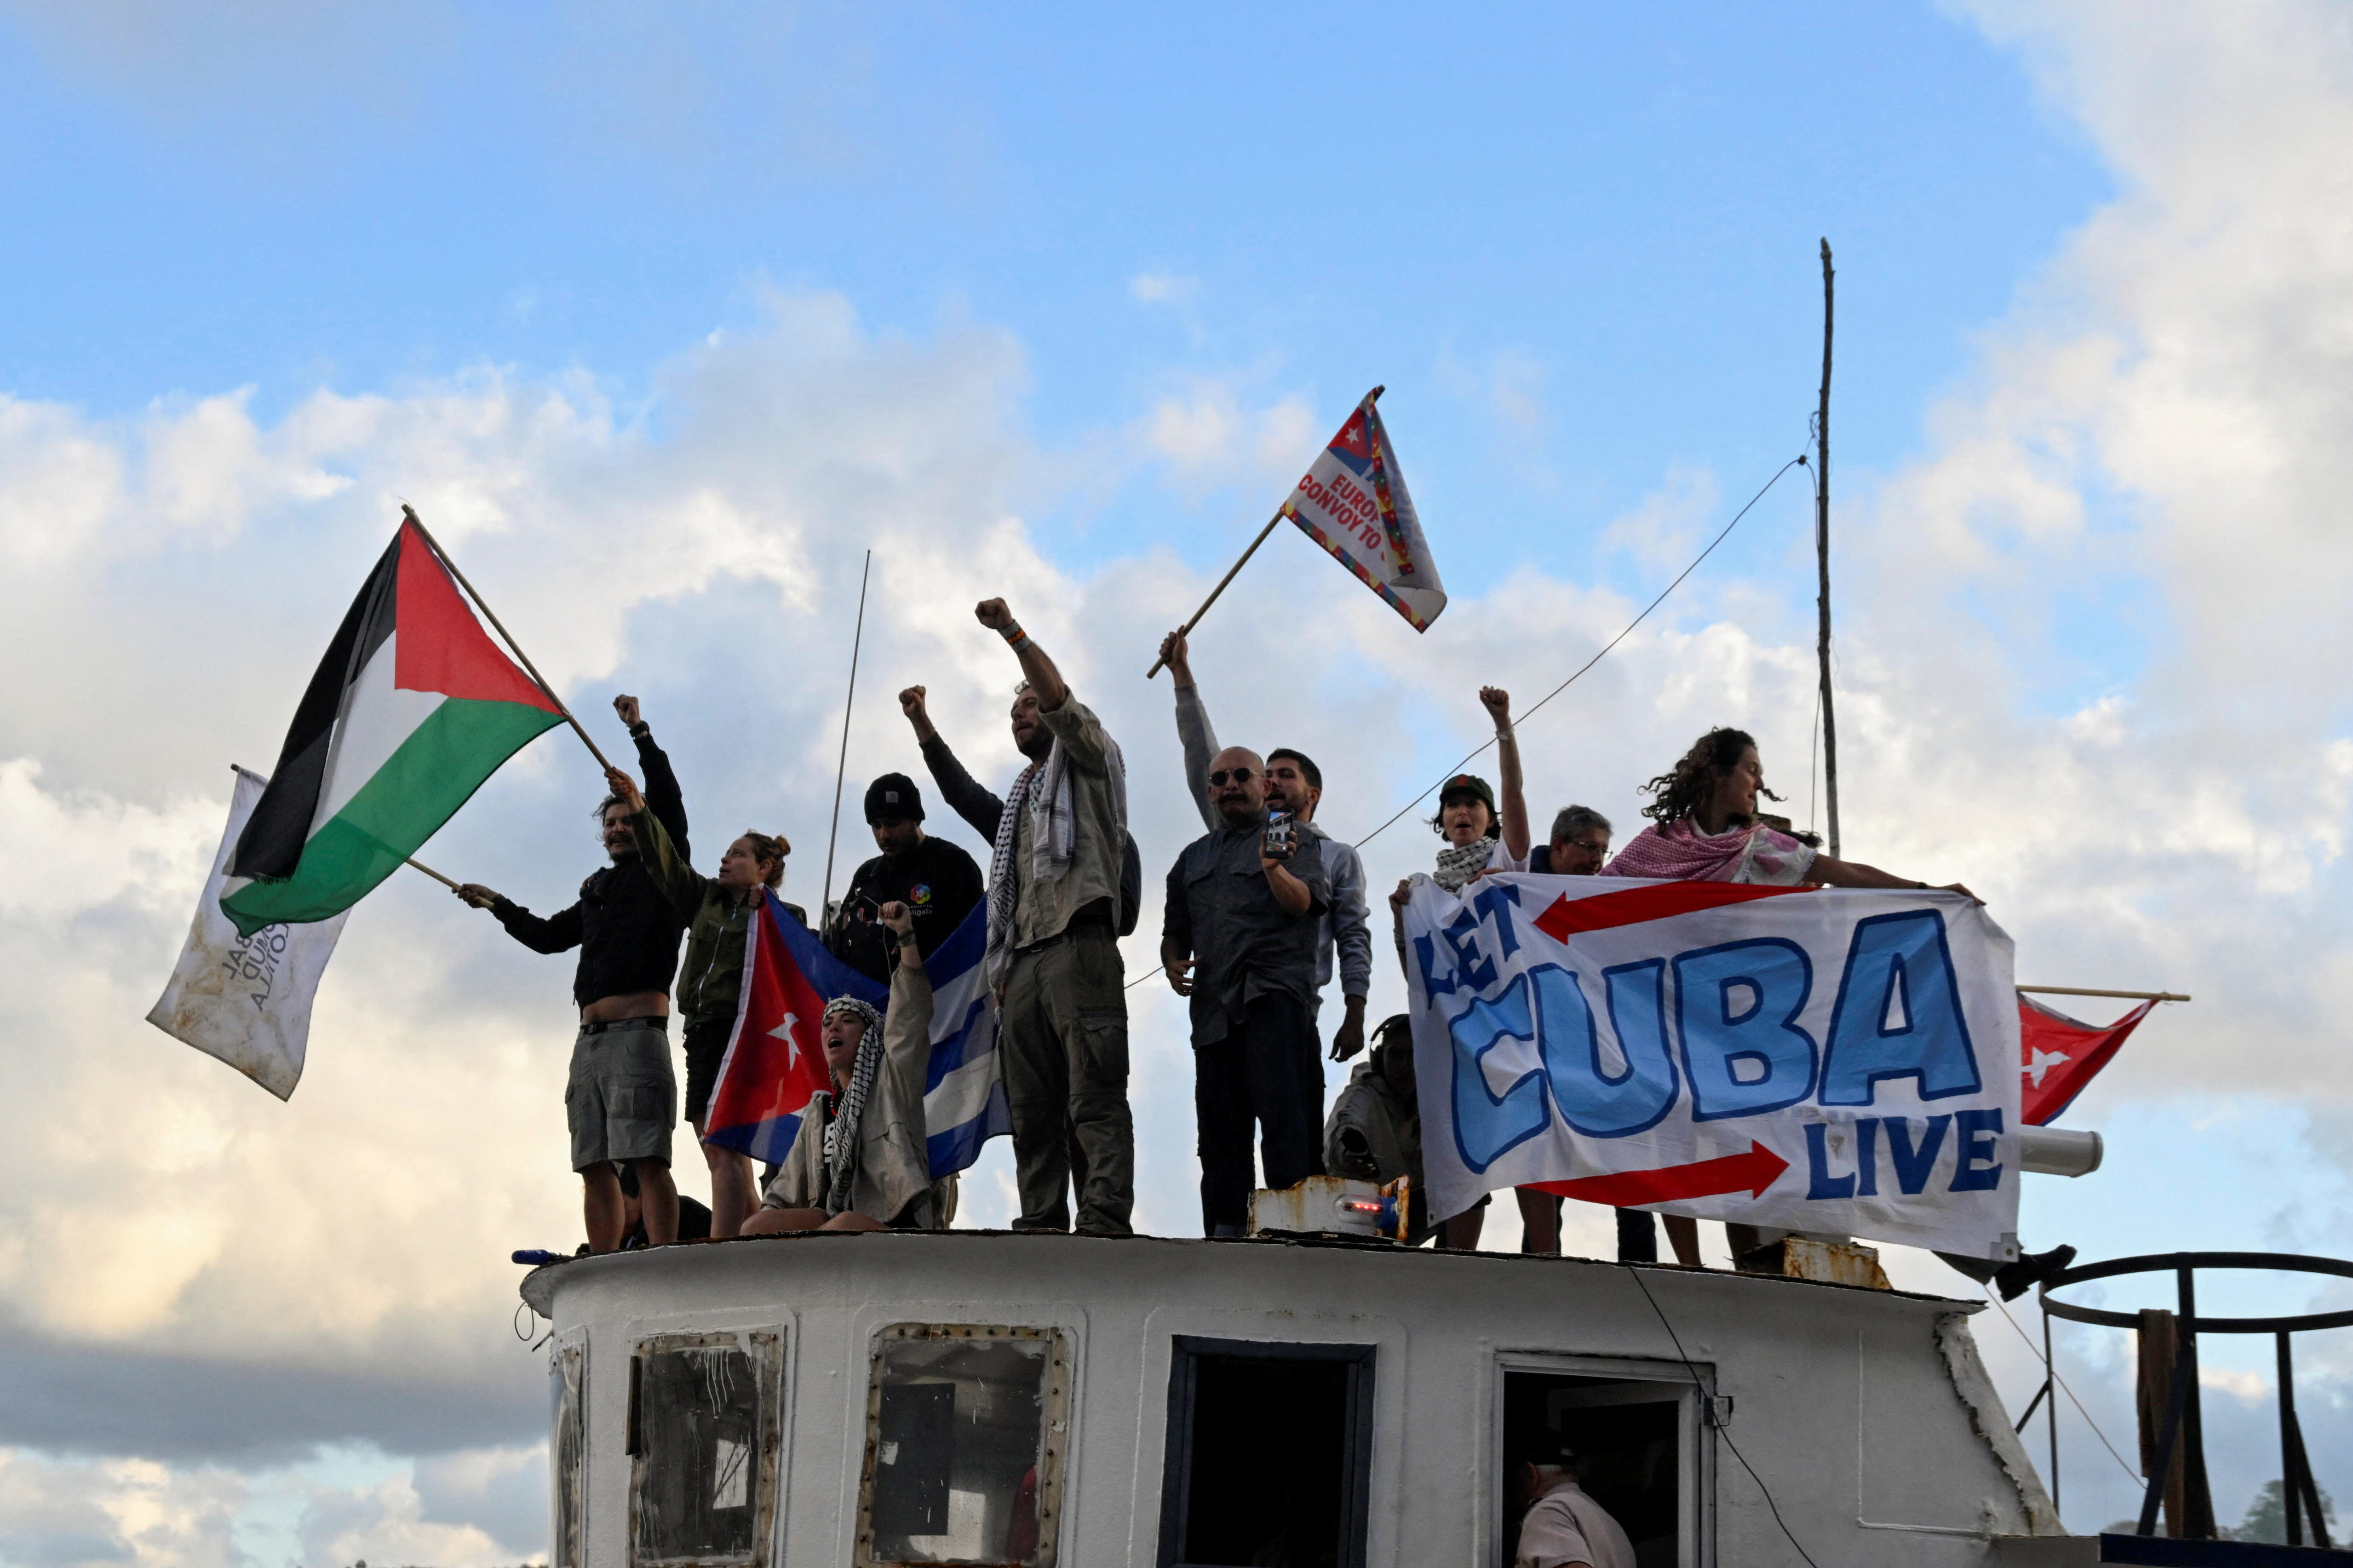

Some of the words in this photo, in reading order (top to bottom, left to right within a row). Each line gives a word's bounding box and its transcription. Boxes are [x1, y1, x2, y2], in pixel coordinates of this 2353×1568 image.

[1298, 474, 1364, 532] CONVOY
[1358, 524, 1382, 550] TO
[1330, 472, 1379, 523] EUROP
[1413, 884, 1521, 1010] LET
[1449, 908, 1982, 1174] CUBA
[1803, 1107, 2004, 1200] LIVE
